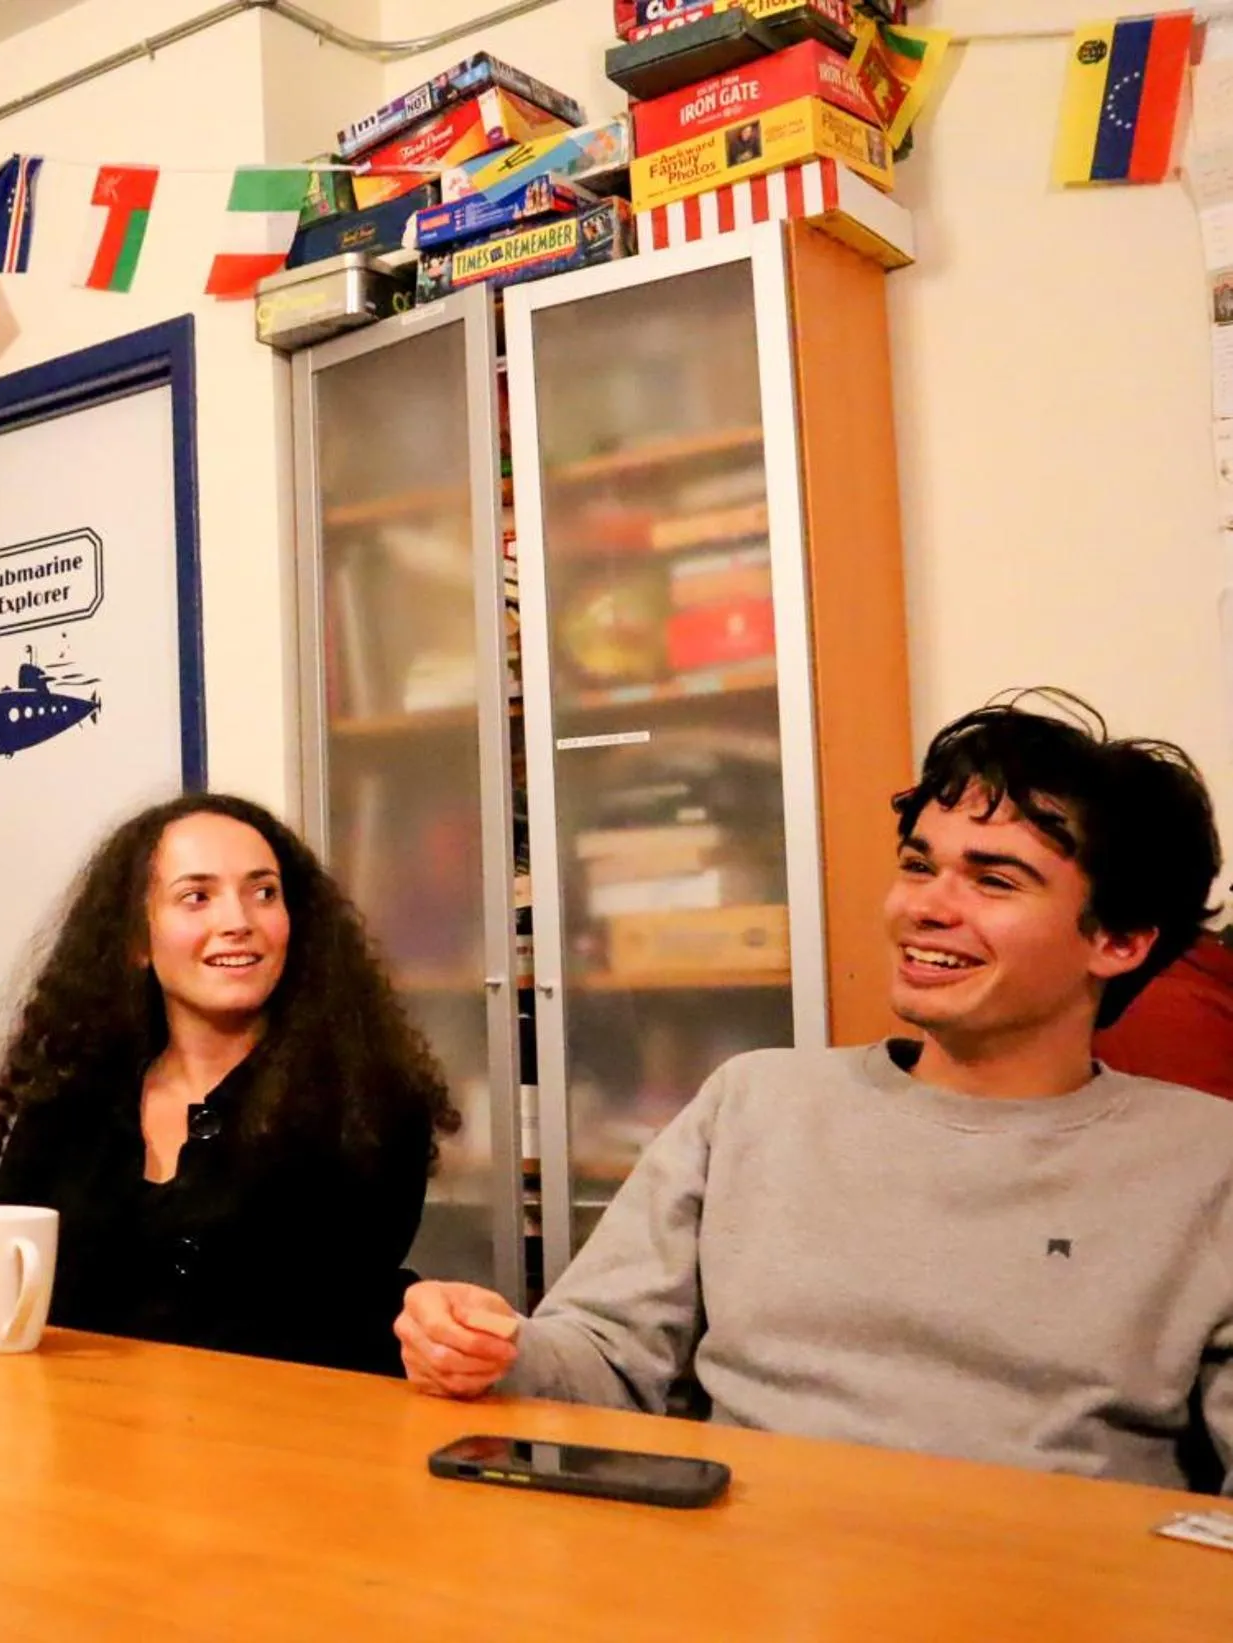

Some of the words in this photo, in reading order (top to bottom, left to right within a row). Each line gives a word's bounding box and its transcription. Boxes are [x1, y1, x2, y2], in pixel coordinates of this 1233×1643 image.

[680, 92, 716, 127] IRON
[719, 80, 760, 107] GATE
[660, 136, 717, 165] Awkward
[668, 162, 717, 184] Photos
[456, 247, 489, 275] TIMES
[504, 224, 572, 261] REMEMBER
